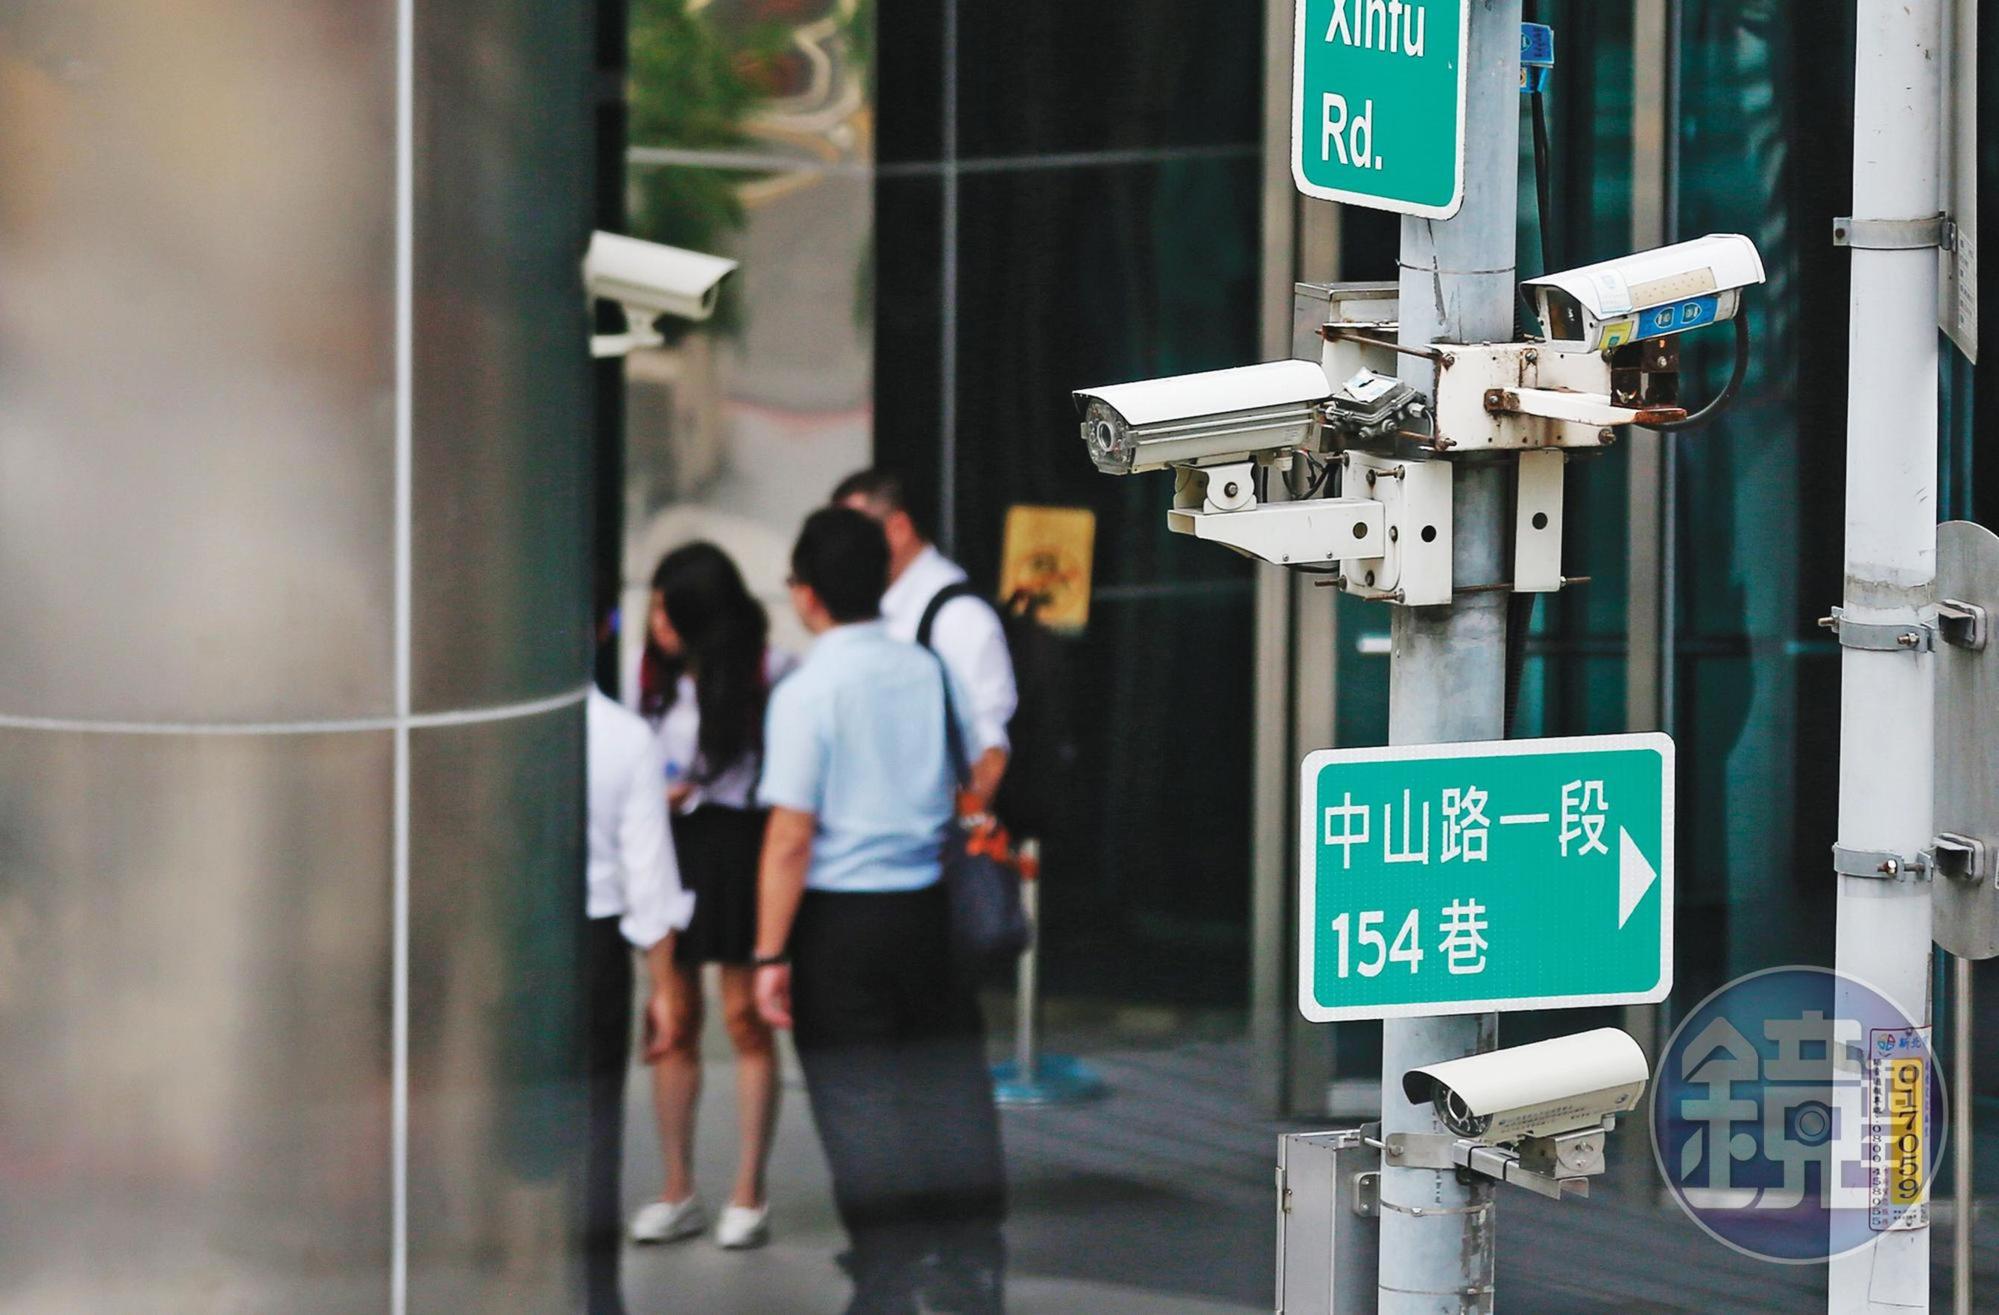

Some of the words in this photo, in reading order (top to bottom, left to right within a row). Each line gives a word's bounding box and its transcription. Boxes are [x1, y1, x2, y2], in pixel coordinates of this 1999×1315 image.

[1325, 0, 1425, 57] Xinfu
[1322, 92, 1383, 170] Rd.
[1325, 779, 1609, 869] 中山路一段
[1898, 1064, 1919, 1199] 017059
